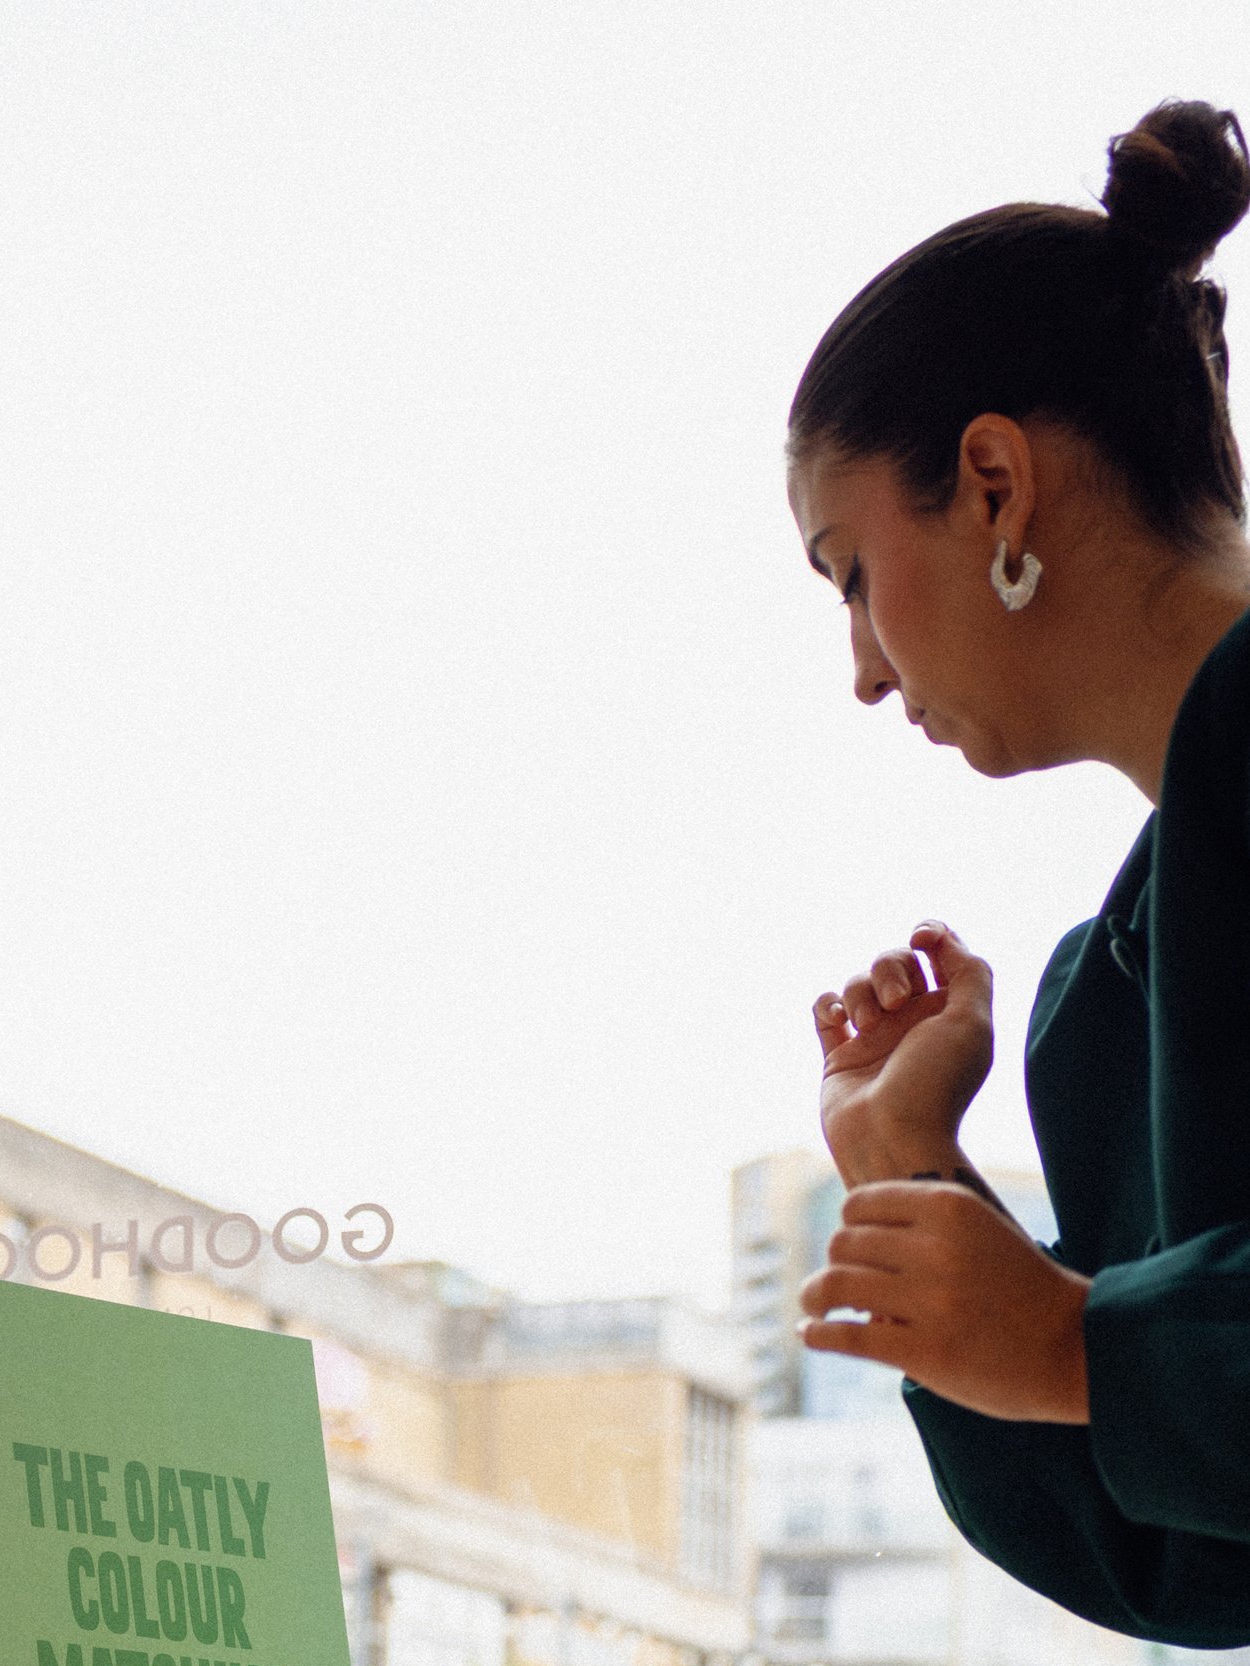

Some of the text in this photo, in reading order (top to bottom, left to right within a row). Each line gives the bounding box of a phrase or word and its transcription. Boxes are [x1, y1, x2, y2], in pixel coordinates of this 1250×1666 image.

[12, 1442, 271, 1560] THE OATLY
[67, 1546, 252, 1650] COLOUR
